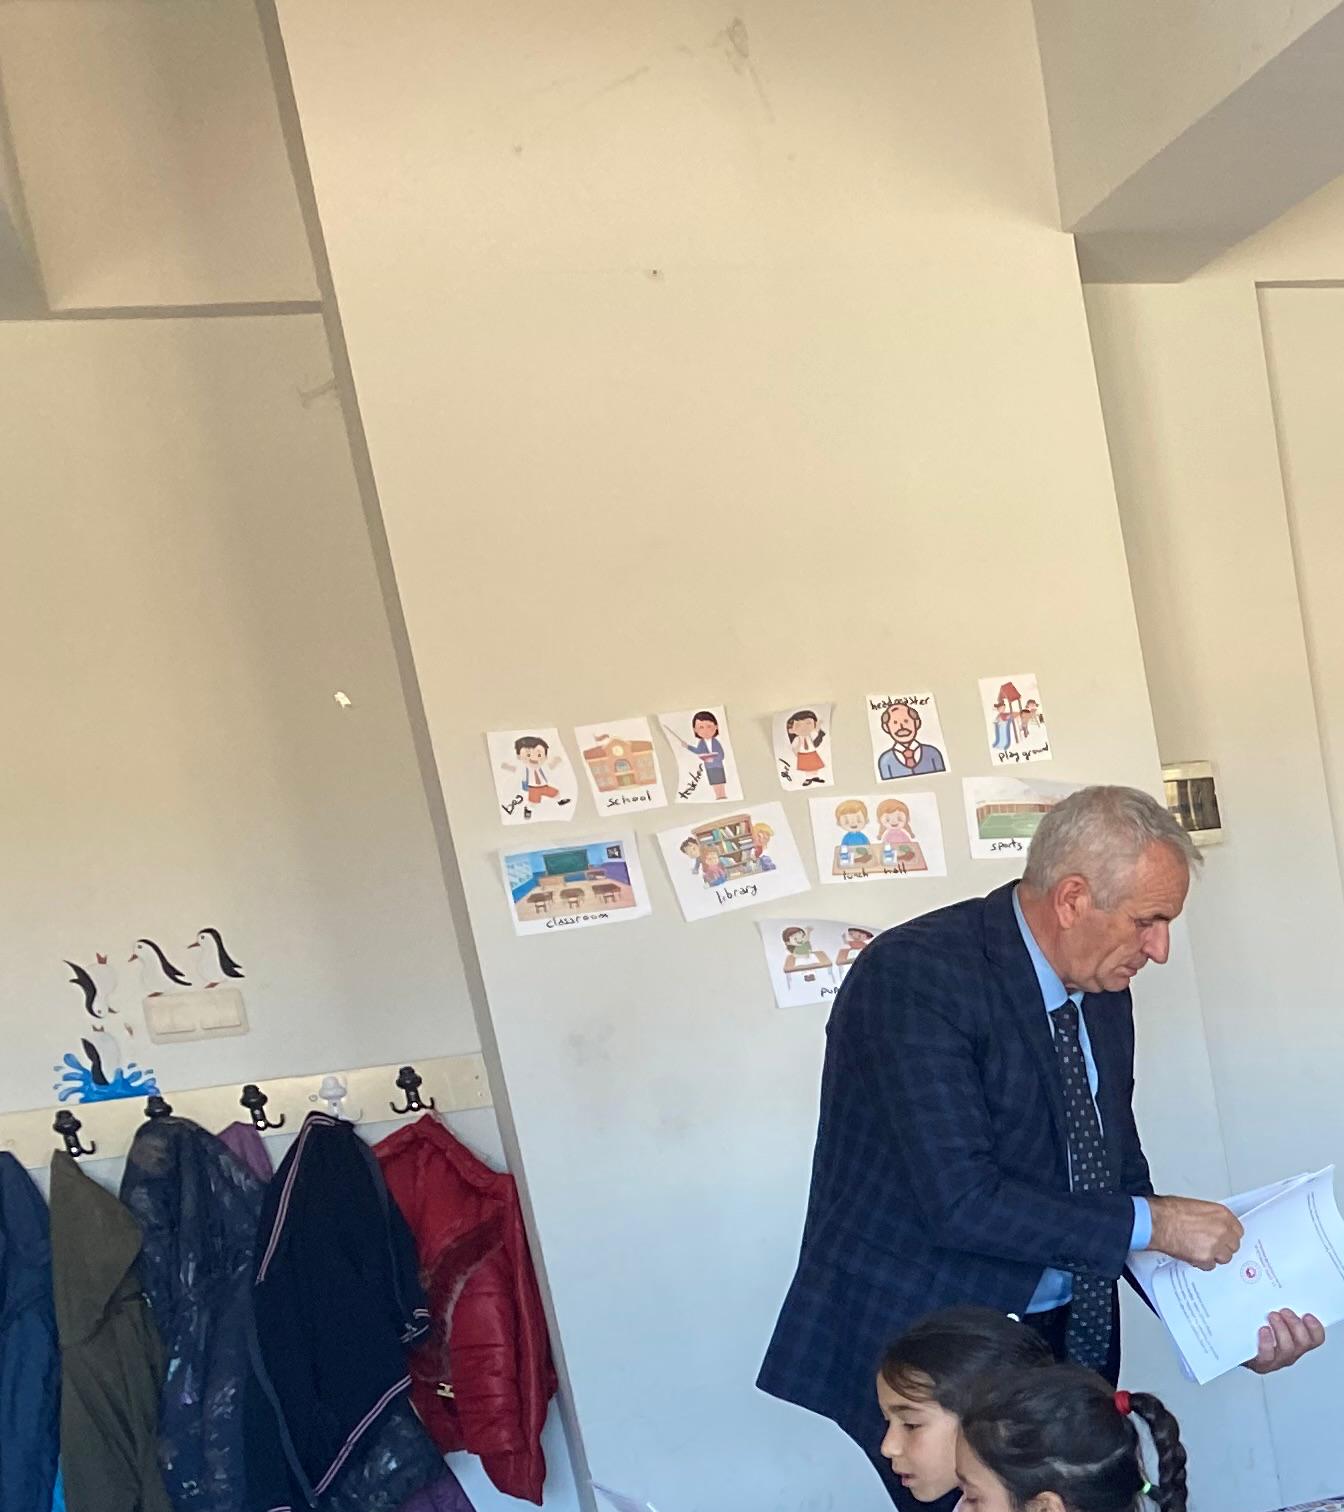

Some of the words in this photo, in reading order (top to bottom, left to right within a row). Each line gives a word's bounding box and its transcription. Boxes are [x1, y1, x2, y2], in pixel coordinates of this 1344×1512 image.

[607, 790, 652, 808] school
[990, 838, 1023, 851] sports
[715, 883, 757, 904] library
[546, 913, 608, 928] classroom
